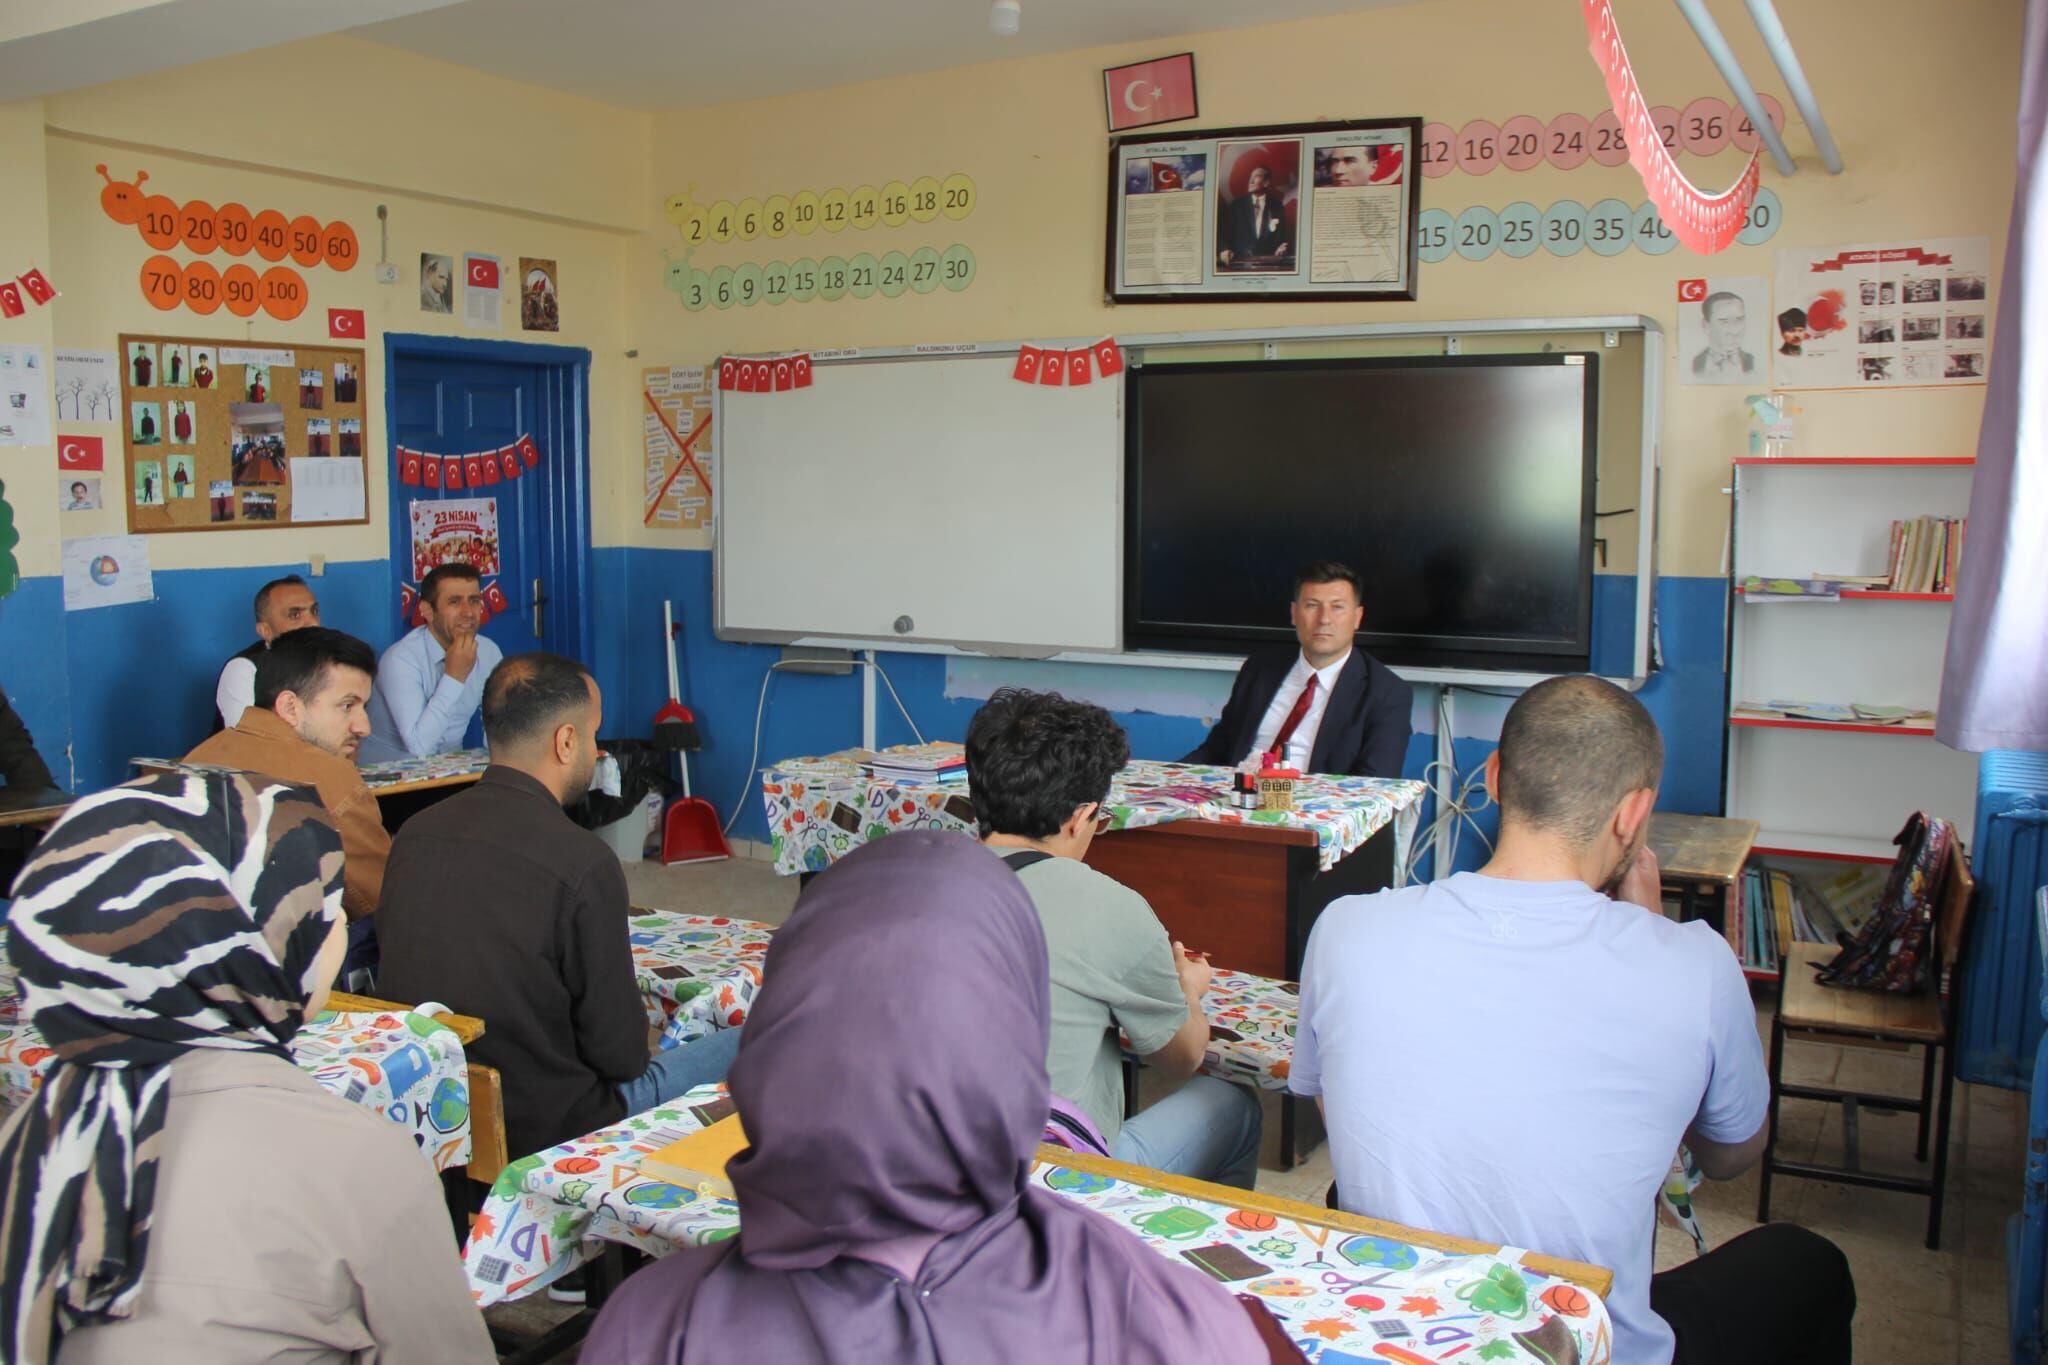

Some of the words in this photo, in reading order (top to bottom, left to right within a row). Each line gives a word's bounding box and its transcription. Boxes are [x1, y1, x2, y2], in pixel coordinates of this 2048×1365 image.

[1421, 141, 1449, 163] 12
[1465, 138, 1494, 160] 16
[1506, 134, 1538, 156] 20
[1552, 131, 1583, 154] 24
[1597, 128, 1626, 151] 28
[1689, 117, 1722, 140] 36
[147, 213, 174, 236] 10
[186, 217, 213, 241] 20
[222, 219, 248, 243] 30
[258, 226, 284, 249] 40
[293, 232, 318, 254] 50
[327, 237, 351, 259] 60
[691, 219, 701, 240] 2
[717, 216, 729, 237] 4
[744, 213, 755, 234] 6
[772, 211, 785, 231] 8
[795, 204, 814, 222] 10
[825, 202, 844, 221] 12
[854, 199, 874, 218] 14
[885, 195, 905, 215] 16
[915, 191, 936, 211] 18
[946, 188, 969, 208] 20
[1419, 226, 1447, 248] 15
[1461, 224, 1491, 246] 20
[1504, 220, 1534, 242] 25
[1548, 219, 1580, 241] 30
[1593, 218, 1625, 240] 35
[1639, 217, 1672, 239] 40
[148, 272, 177, 296] 70
[188, 277, 216, 301] 80
[227, 281, 254, 303] 90
[267, 282, 298, 302] 100
[691, 284, 701, 305] 3
[718, 281, 729, 303] 6
[743, 279, 754, 300] 9
[767, 275, 786, 294] 12
[795, 272, 814, 290] 15
[824, 270, 844, 289] 18
[852, 268, 872, 286] 21
[883, 266, 904, 285] 24
[914, 262, 935, 281] 27
[946, 260, 968, 279] 30
[434, 511, 447, 525] 23
